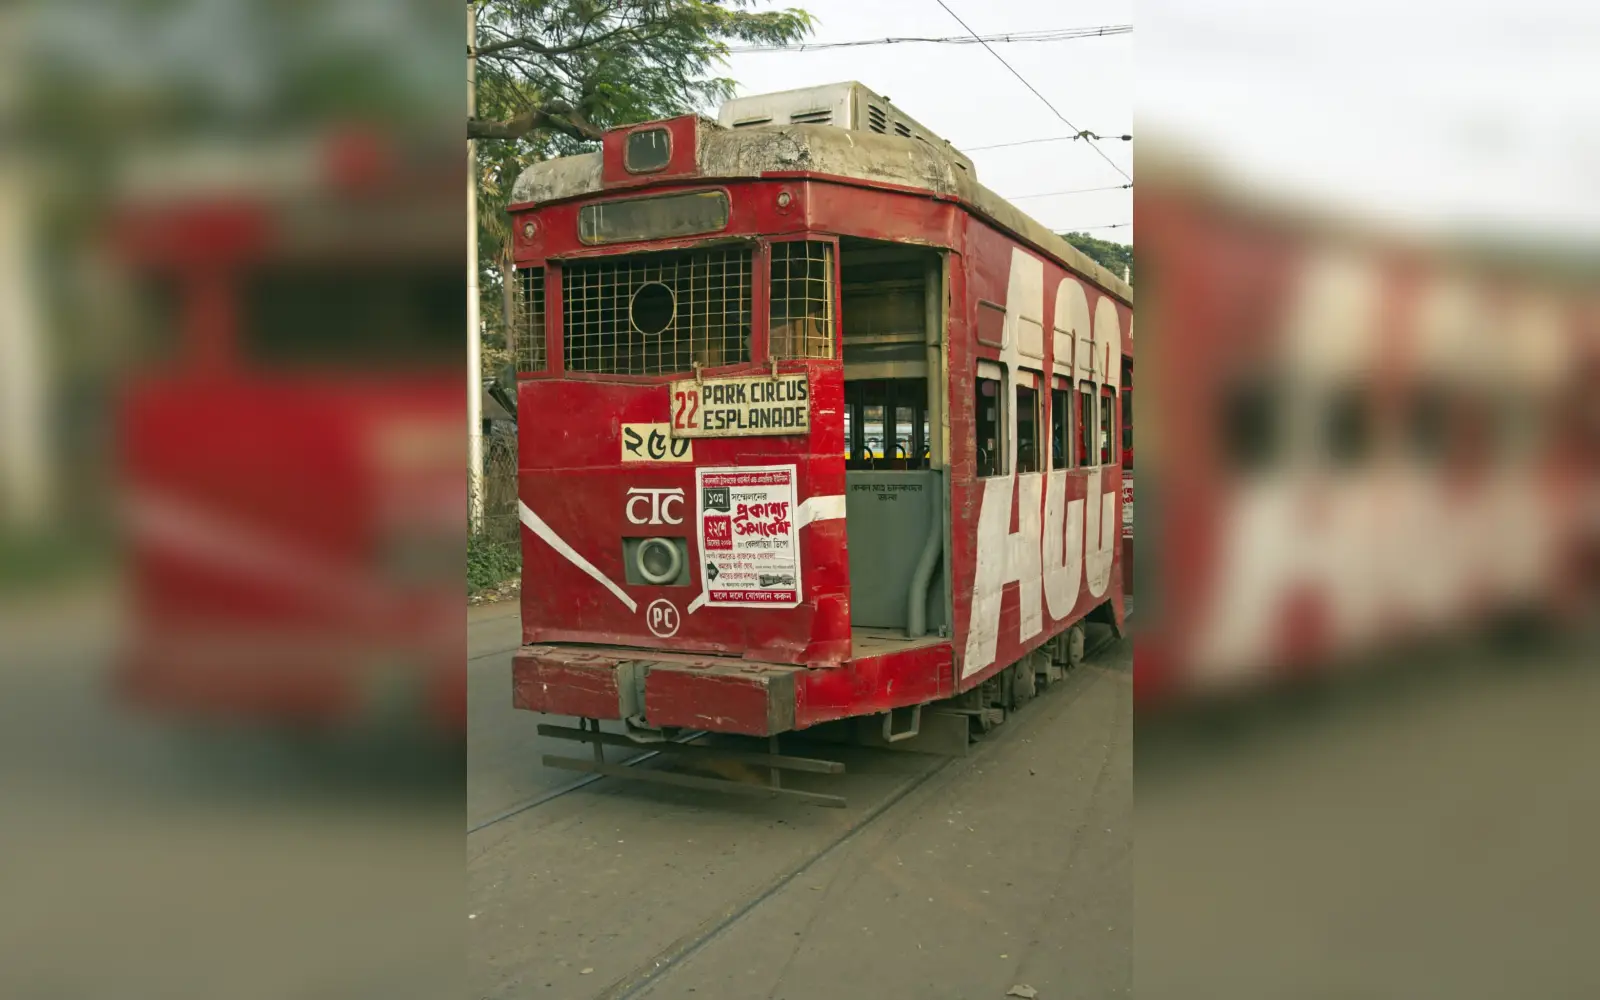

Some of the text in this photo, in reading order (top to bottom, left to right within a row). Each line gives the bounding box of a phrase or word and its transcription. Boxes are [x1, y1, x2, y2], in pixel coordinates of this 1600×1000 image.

[702, 379, 807, 406] PARK CIRCUS
[675, 391, 699, 430] 22
[703, 406, 806, 430] ESPLANADE
[626, 487, 685, 525] CTC
[731, 492, 767, 501] সম্মেলনের
[732, 502, 789, 523] প্রকাশ্য
[713, 591, 728, 600] দলে
[729, 591, 744, 600] দলে
[653, 607, 673, 628] PC
